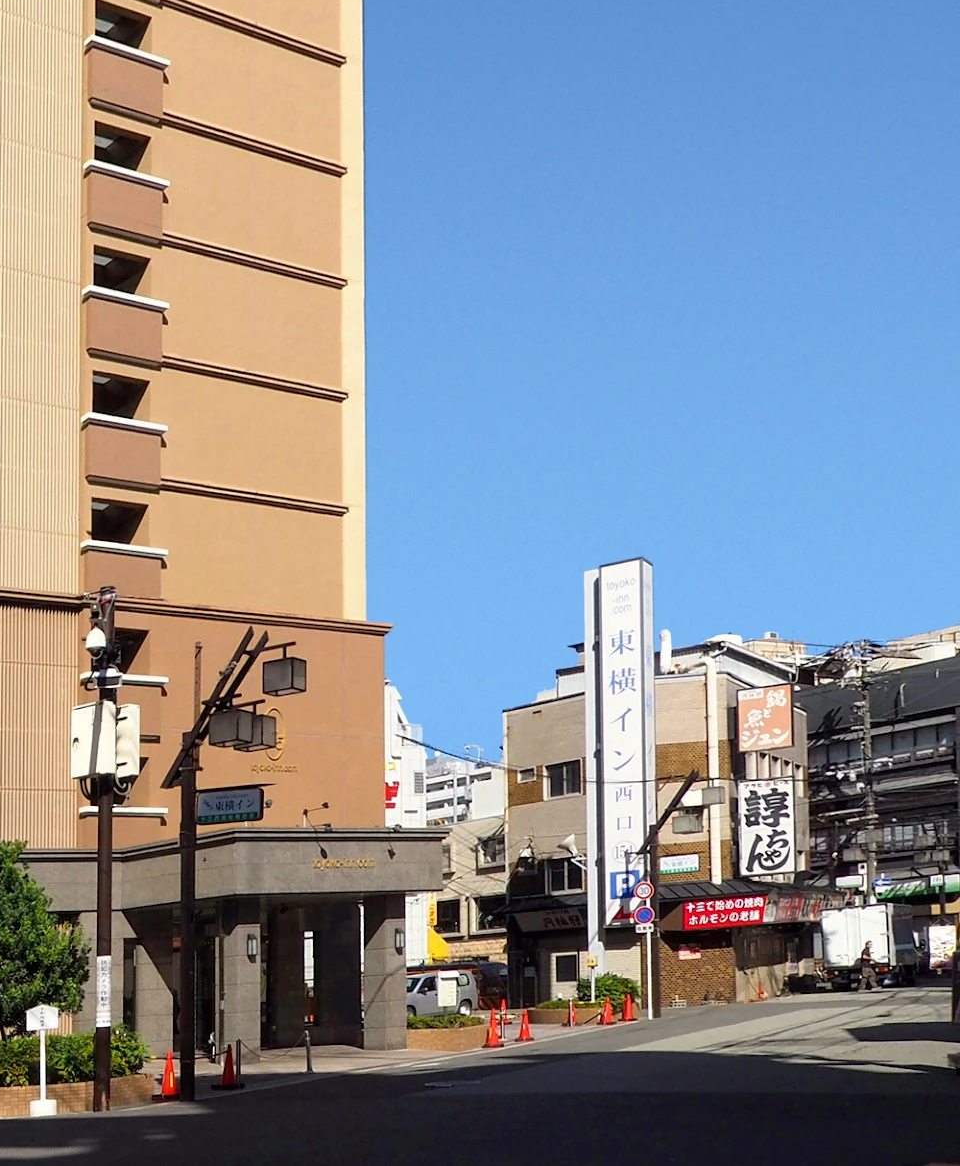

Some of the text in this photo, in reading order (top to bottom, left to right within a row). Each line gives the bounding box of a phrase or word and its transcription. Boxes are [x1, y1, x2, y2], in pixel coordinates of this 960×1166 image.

[606, 577, 636, 592] toyoko
[608, 629, 637, 771] 東横イン
[615, 785, 632, 831] 西口
[639, 887, 649, 895] 30
[686, 897, 765, 914] 十三で始めの焼肉
[689, 910, 760, 925] ホルモンの老舗
